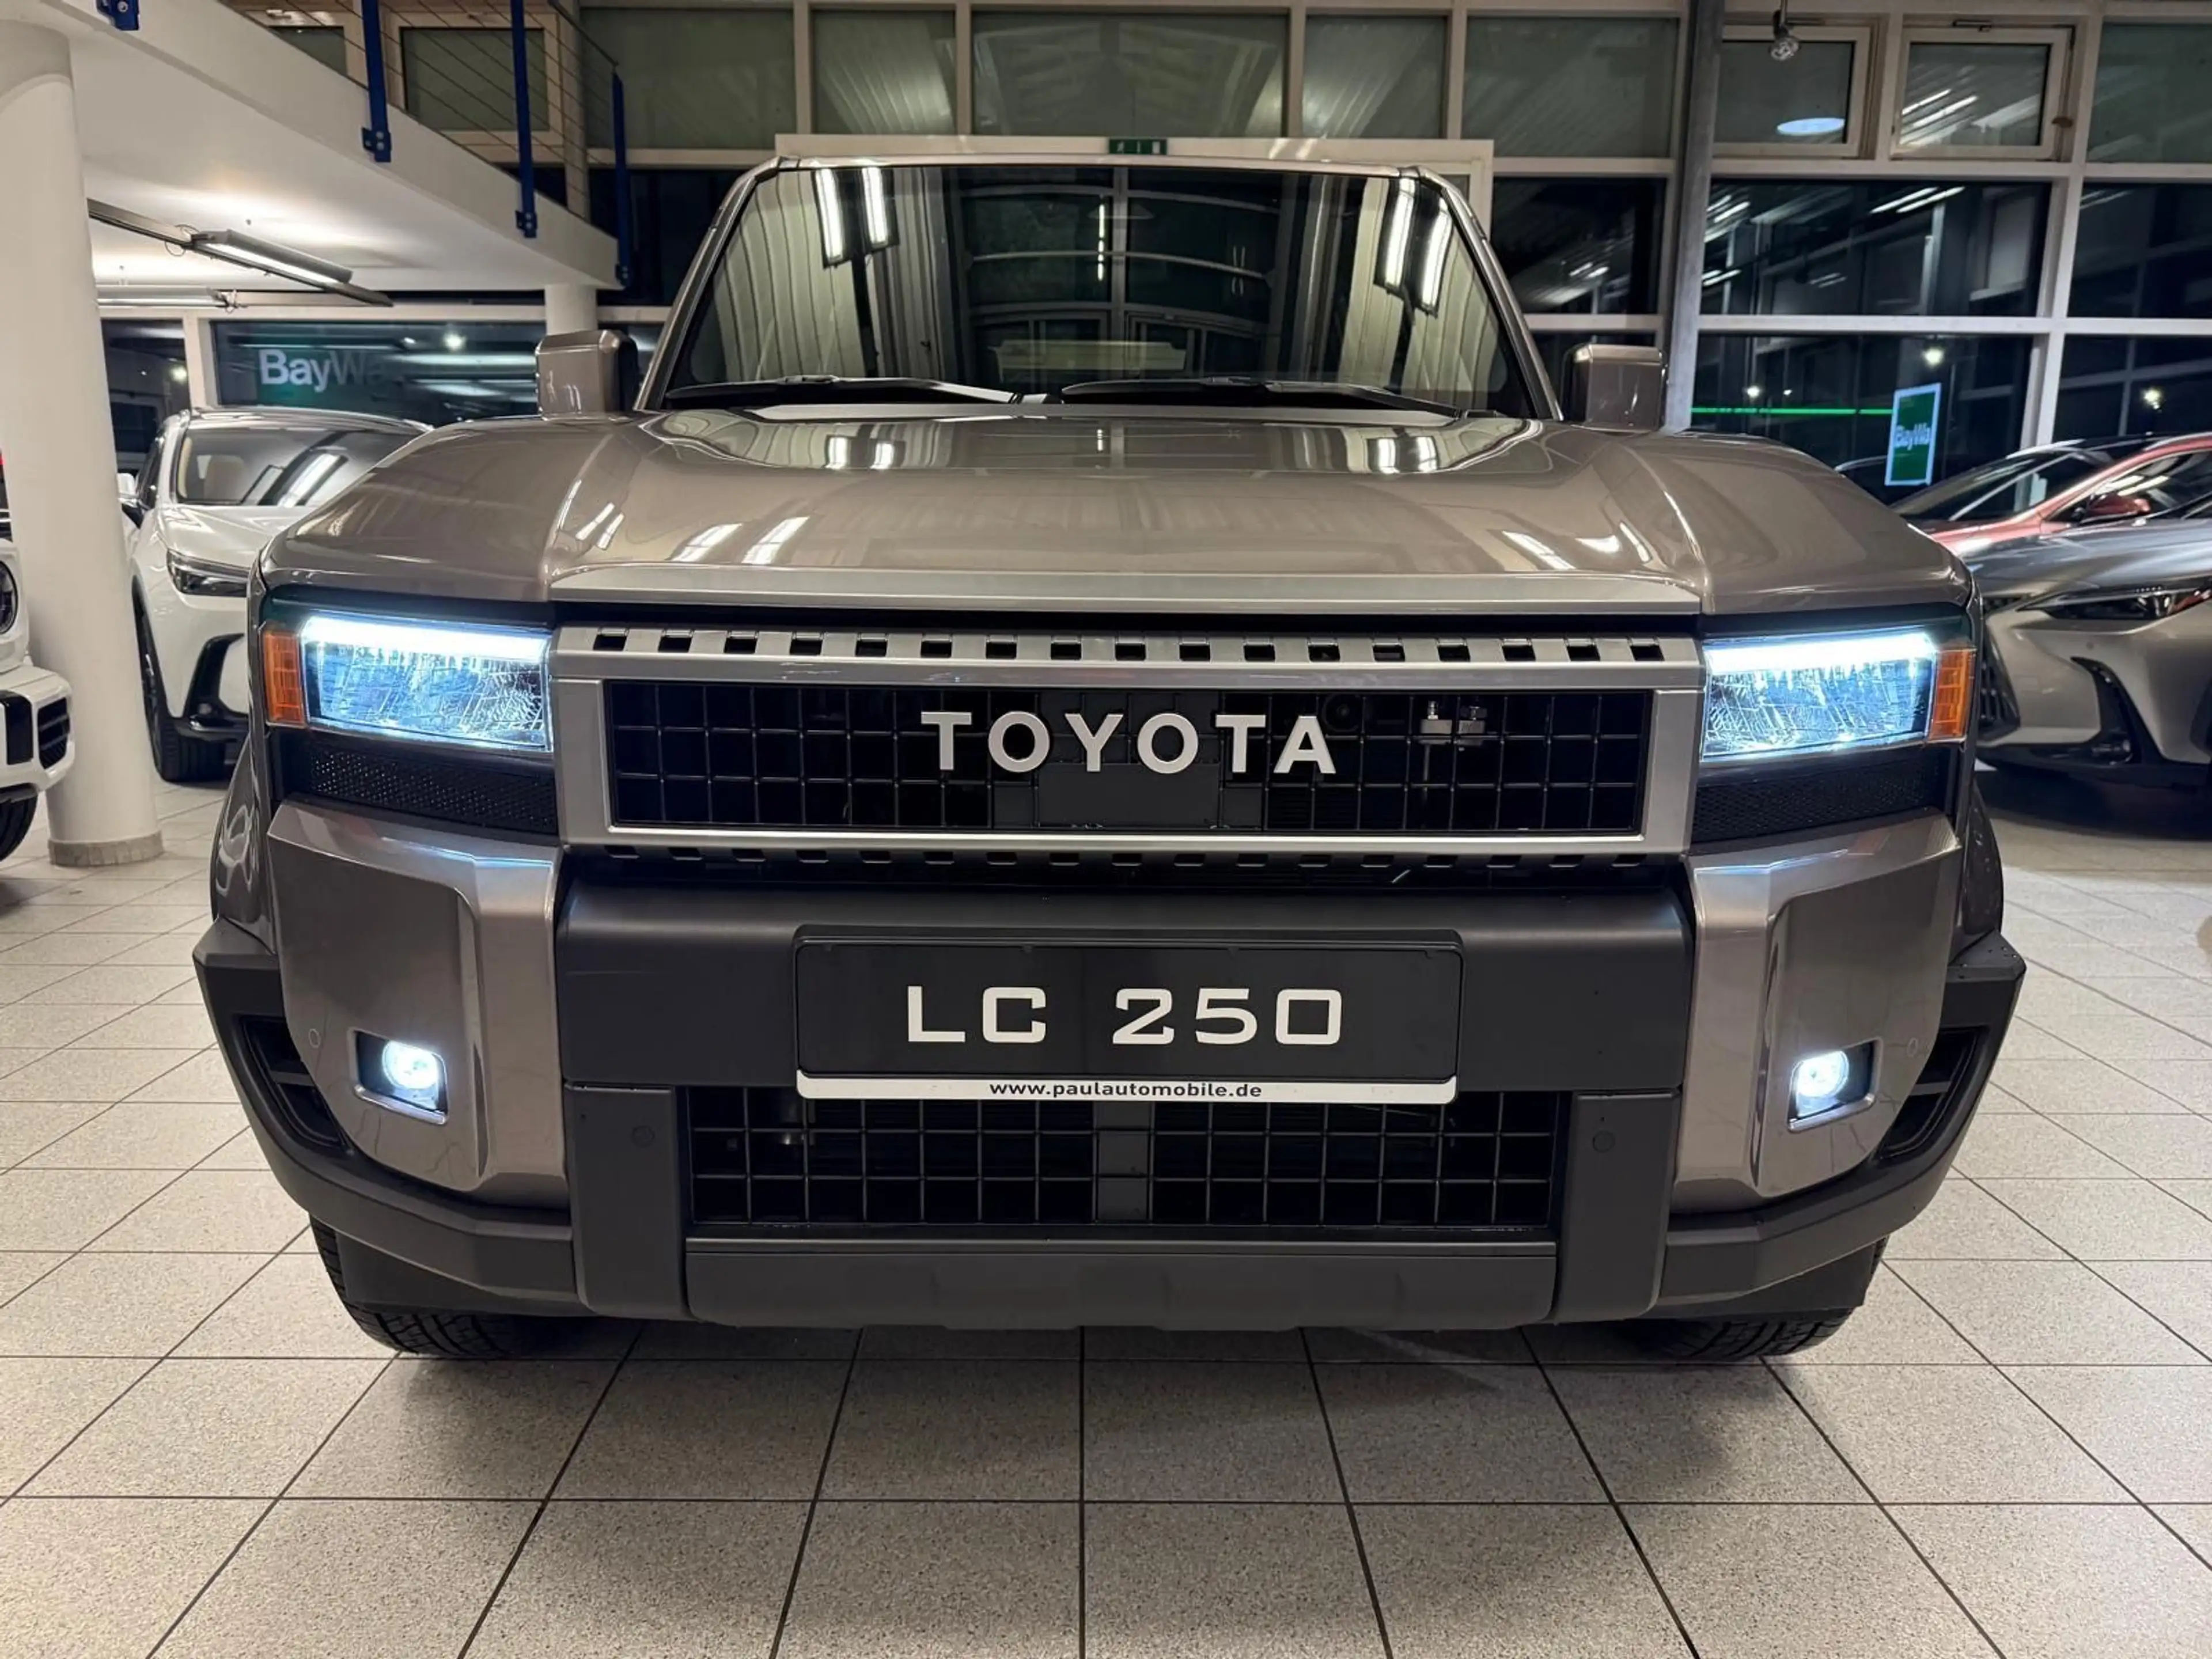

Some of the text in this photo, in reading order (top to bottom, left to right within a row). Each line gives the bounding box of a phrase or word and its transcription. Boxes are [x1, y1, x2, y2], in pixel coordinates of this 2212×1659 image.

[921, 711, 1336, 774] TOYOTA
[907, 986, 1343, 1046] LC 250
[990, 1082, 1263, 1098] www.paulautomobile.de
